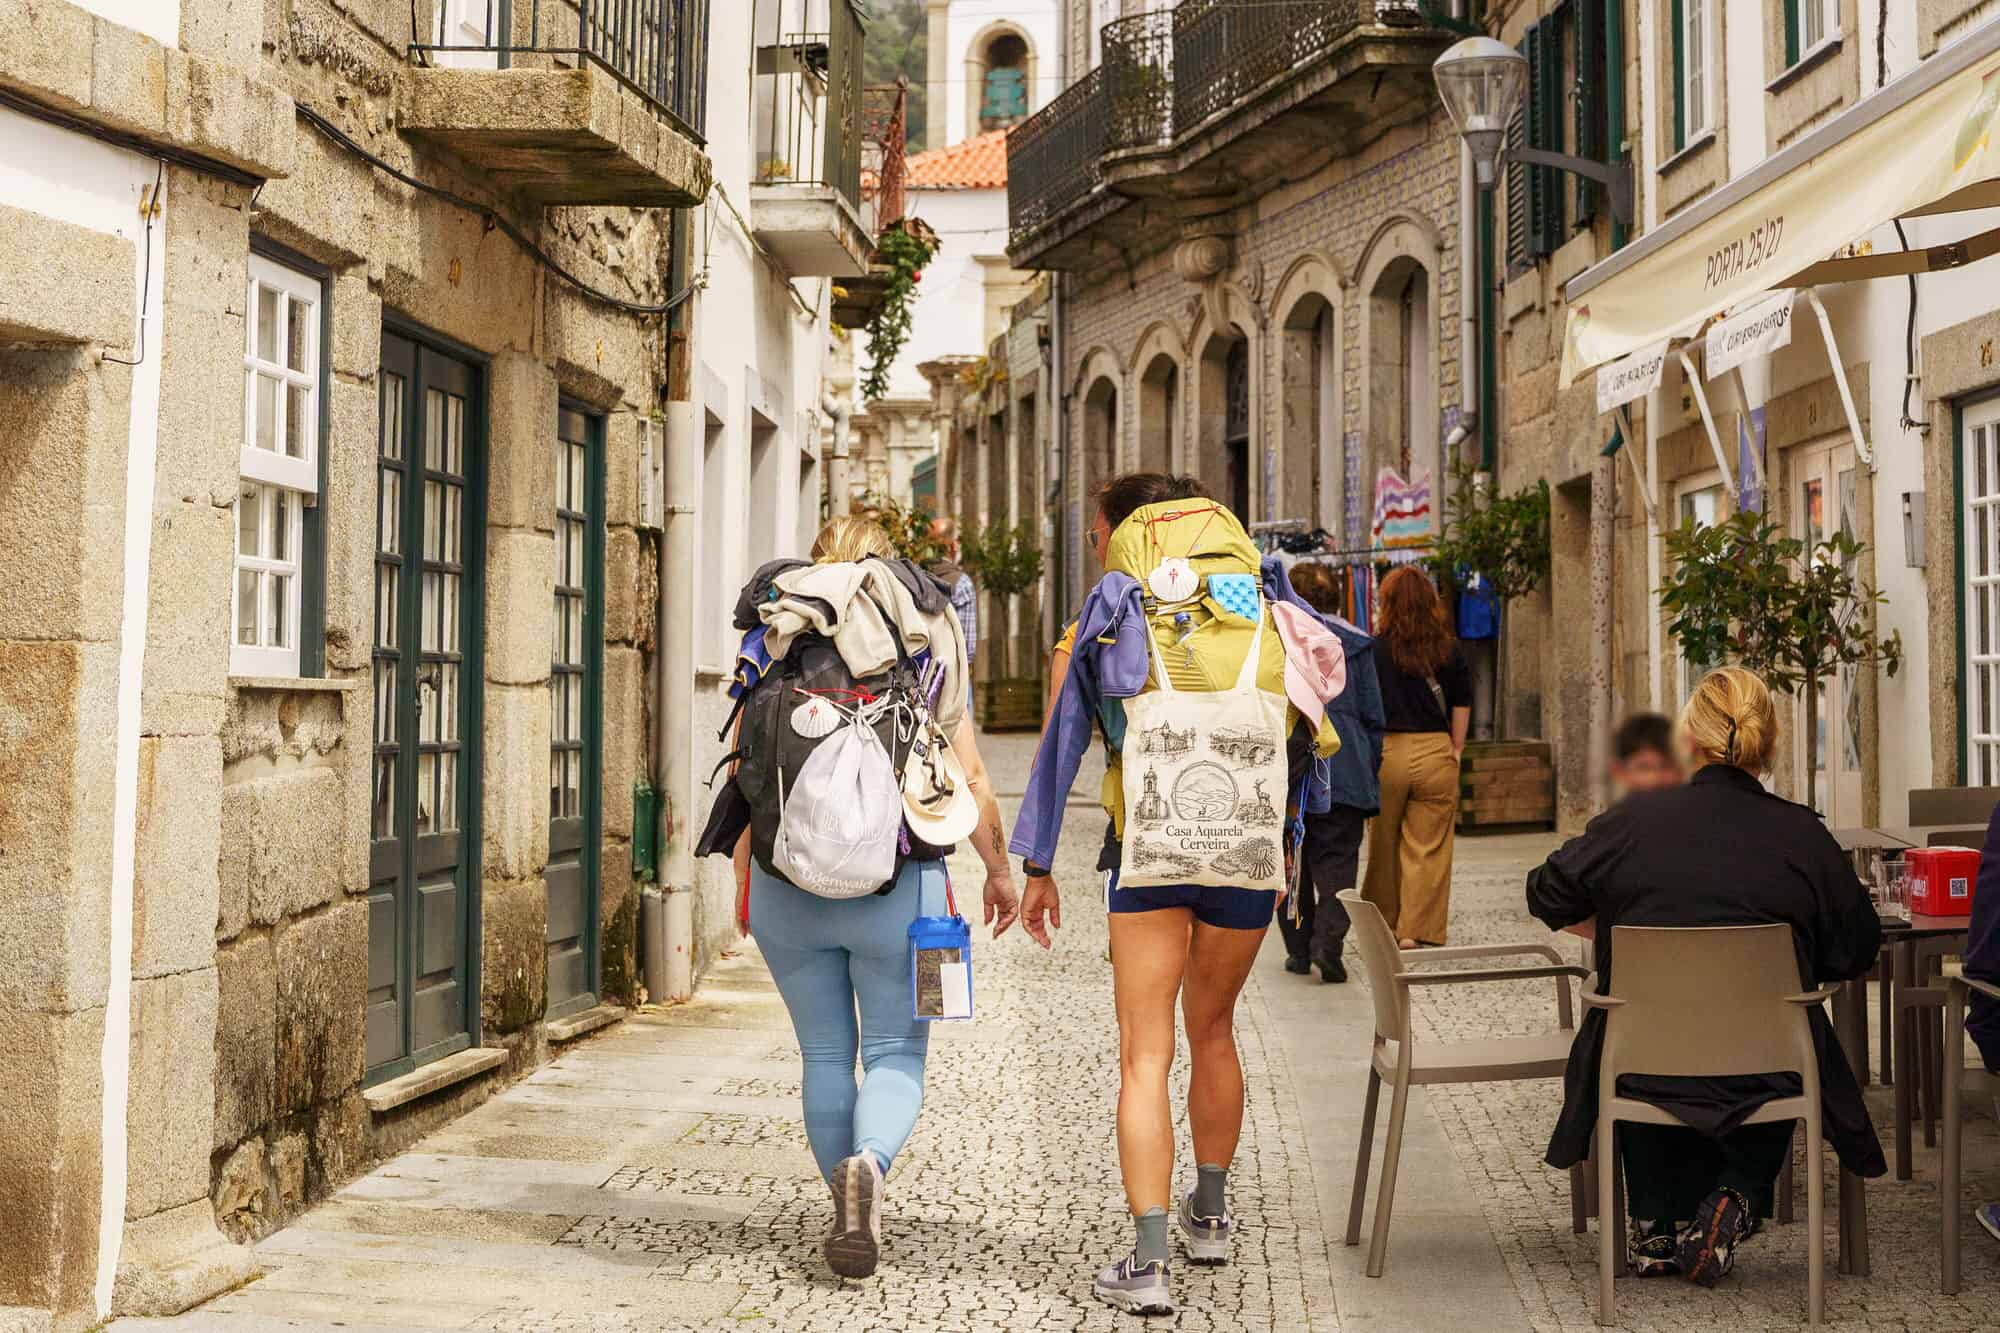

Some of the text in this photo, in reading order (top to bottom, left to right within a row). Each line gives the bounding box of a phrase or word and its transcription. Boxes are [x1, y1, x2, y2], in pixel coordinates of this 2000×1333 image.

[1704, 216, 1784, 290] PORTA 25/27
[1166, 825, 1243, 839] Casa Aquarela
[1180, 838, 1230, 850] Cerveira
[802, 870, 874, 889] Odenwald
